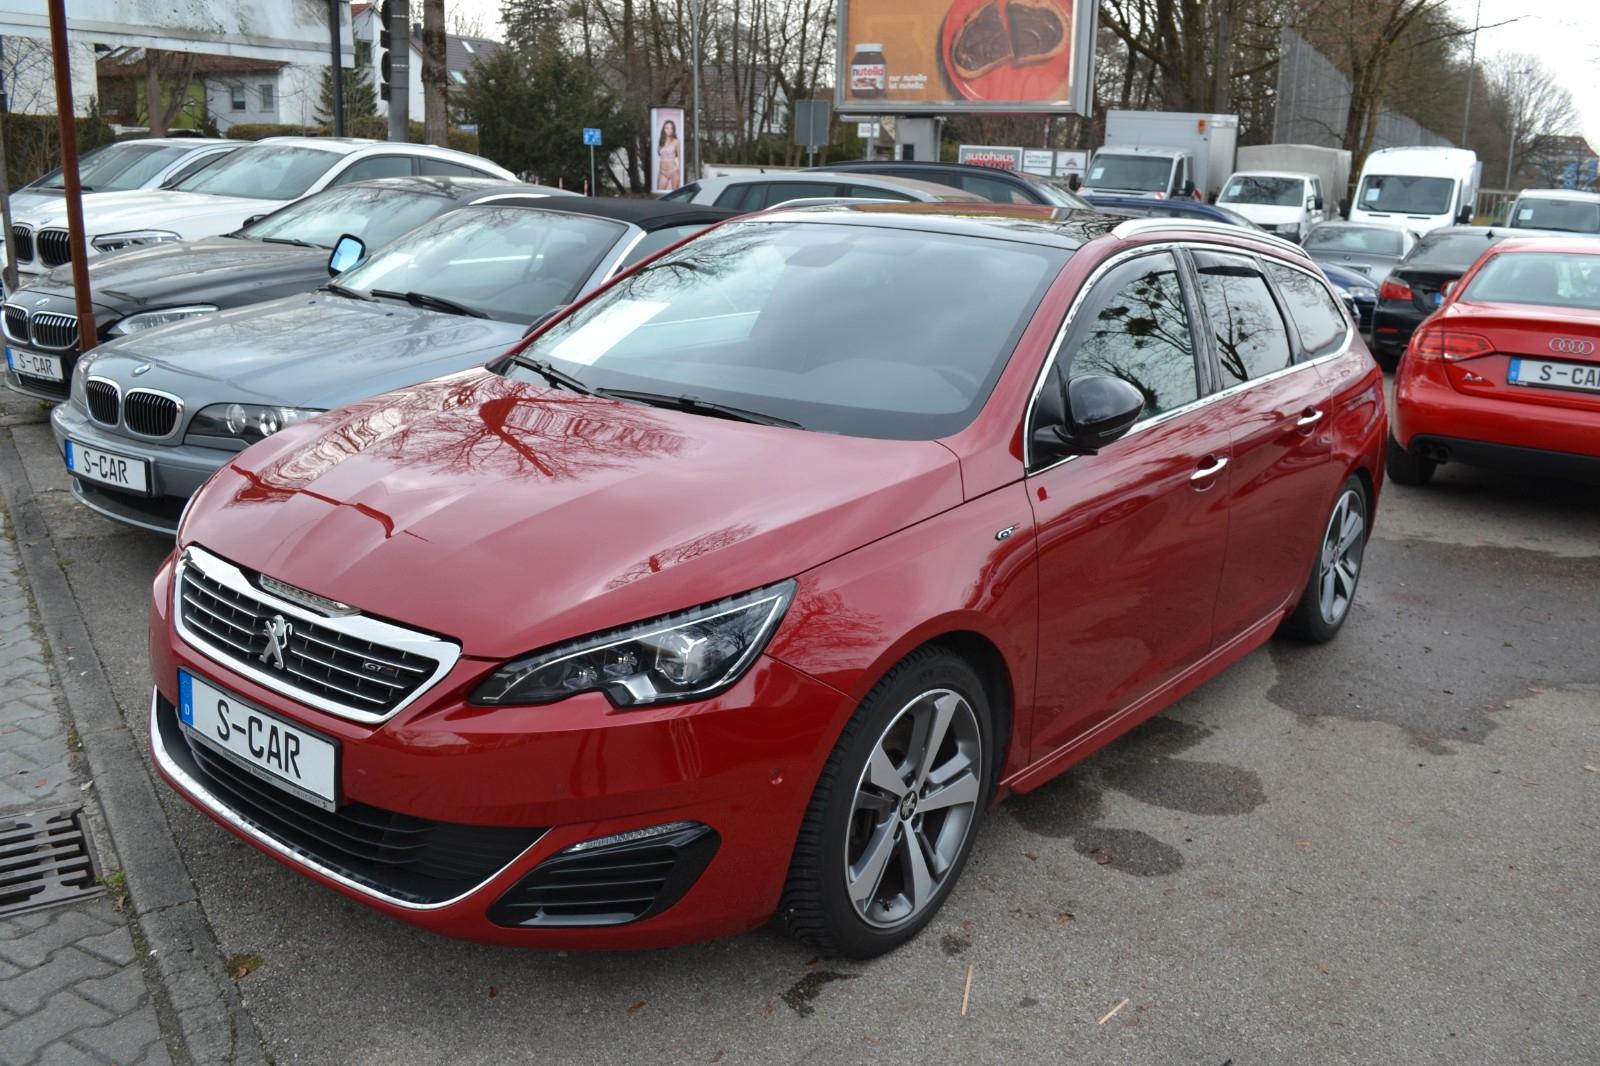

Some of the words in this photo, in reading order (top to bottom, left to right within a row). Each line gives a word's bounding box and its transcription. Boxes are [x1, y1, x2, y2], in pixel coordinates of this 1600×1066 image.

[852, 66, 885, 76] nutella
[902, 73, 928, 82] nutella
[965, 151, 1016, 163] autohaus
[19, 353, 54, 376] S-CAR
[83, 451, 129, 484] S-CAR
[216, 699, 302, 779] S-CAR
